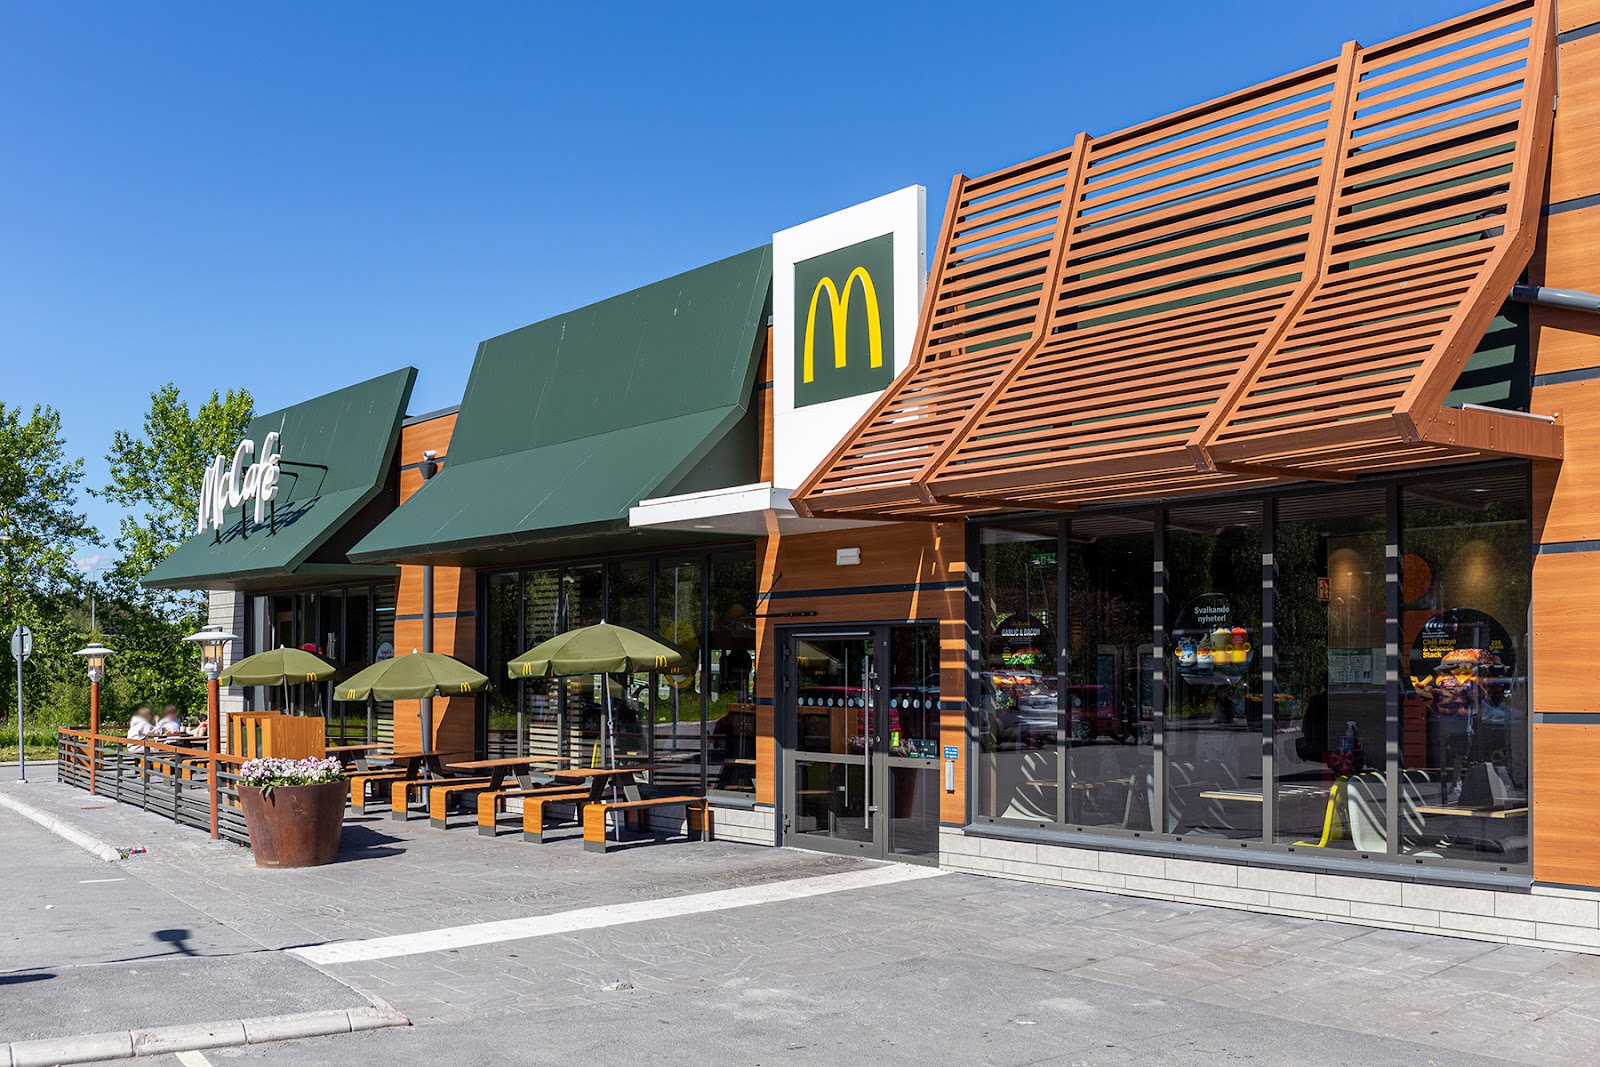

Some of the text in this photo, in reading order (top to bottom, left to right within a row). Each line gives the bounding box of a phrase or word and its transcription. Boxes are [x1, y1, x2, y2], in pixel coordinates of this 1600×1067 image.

[198, 431, 281, 535] McCafé
[1194, 606, 1230, 614] Svalkande
[1198, 614, 1226, 624] nyheter!
[1001, 628, 1019, 636] GARLIC
[1024, 628, 1040, 636] BACON
[1438, 638, 1457, 646] Mayo
